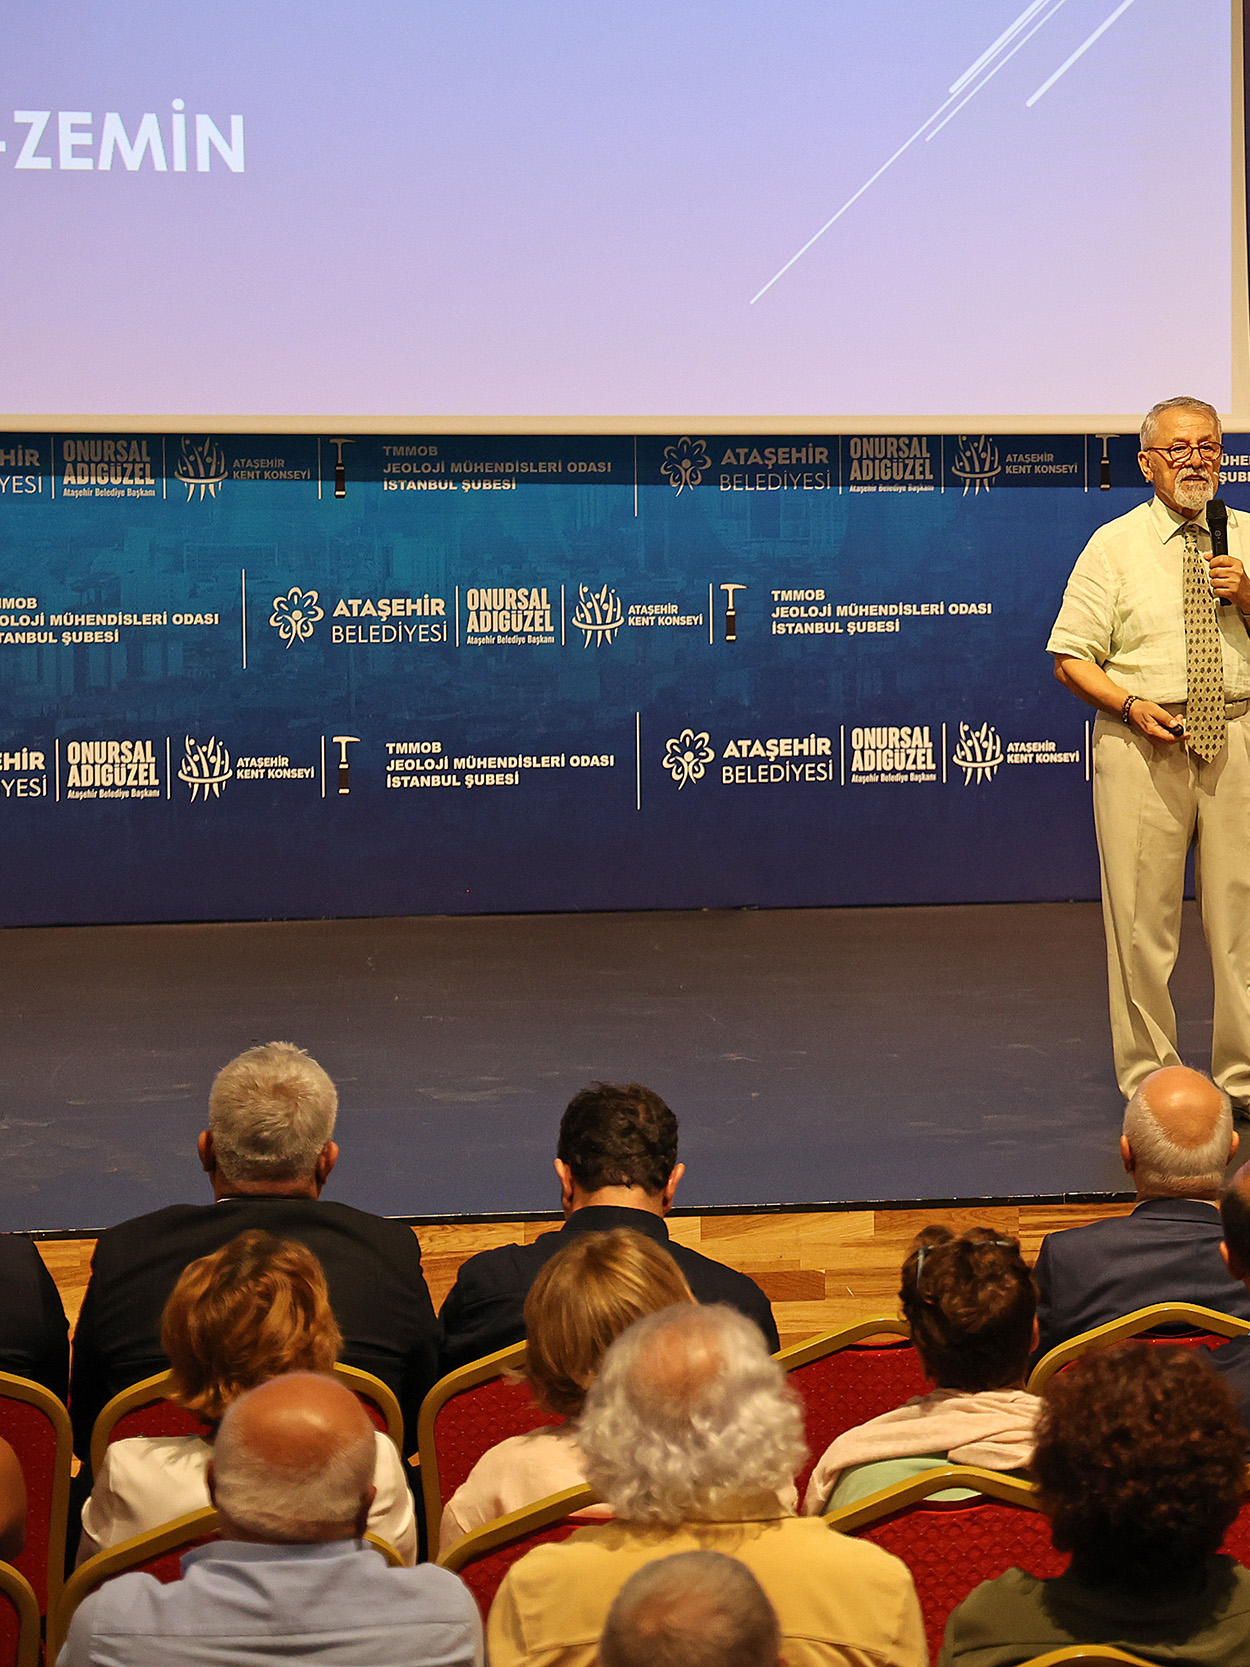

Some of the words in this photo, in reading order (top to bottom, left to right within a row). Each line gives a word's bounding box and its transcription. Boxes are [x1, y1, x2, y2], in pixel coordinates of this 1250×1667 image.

[63, 439, 150, 462] ONURSAL
[383, 446, 438, 456] TMMOB
[721, 443, 829, 469] ATAŞEHİR
[850, 437, 931, 459] ONURSAL
[233, 457, 285, 469] ATAŞEHİR
[1006, 452, 1054, 463] ATAŞEHİR
[63, 462, 155, 485] ADIGÜZEL
[233, 469, 262, 480] KENT
[264, 467, 311, 480] KONSEYİ
[383, 460, 445, 474] JEOLOJİ
[450, 459, 563, 473] MÜHENDİSLERİ
[567, 461, 612, 472] ODASI
[850, 459, 933, 480] ADIGÜZEL
[1006, 465, 1032, 474] KENT
[1034, 463, 1078, 474] KONSEYİ
[383, 478, 458, 491] İSTANBUL
[461, 477, 517, 492] ŞUBESİ
[720, 470, 831, 491] BELEDİYESİ
[0, 598, 38, 609] MOB
[467, 588, 551, 611] ONURSAL
[771, 590, 825, 601] TMMOB
[332, 594, 446, 621] ATAŞEHİR
[628, 602, 678, 615] ATAŞEHİR
[771, 605, 832, 618] JEOLOJİ
[836, 602, 944, 616] MÜHENDİSLERİ
[948, 603, 992, 615] ODASI
[50, 611, 168, 626] MÜHENDİSLERİ
[172, 613, 219, 625] ODASI
[467, 610, 554, 633] ADIGÜZEL
[628, 616, 655, 626] KENT
[657, 613, 703, 626] KONSEYİ
[772, 621, 844, 635] İSTANBUL
[846, 618, 900, 635] ŞUBESİ
[62, 629, 119, 646] ŞUBESİ
[332, 621, 447, 644] BELEDİYESİ
[851, 726, 933, 749] ONURSAL
[67, 741, 155, 764] ONURSAL
[386, 742, 442, 754] TMMOB
[723, 734, 832, 762] ATAŞEHİR
[1007, 740, 1056, 753] ATAŞEHİR
[236, 755, 289, 768] ATAŞEHİR
[386, 757, 449, 771] JEOLOJİ
[453, 753, 566, 770] MÜHENDİSLERİ
[570, 755, 615, 767] ODASI
[851, 748, 936, 772] ADIGÜZEL
[1007, 753, 1034, 763] KENT
[1036, 750, 1080, 763] KONSEYİ
[67, 763, 160, 787] ADIGÜZEL
[236, 769, 266, 779] KENT
[268, 766, 315, 779] KONSEYİ
[386, 773, 461, 788] İSTANBUL
[464, 771, 519, 788] ŞUBESİ
[722, 759, 833, 784] BELEDİYESİ
[0, 774, 47, 797] YESİ
